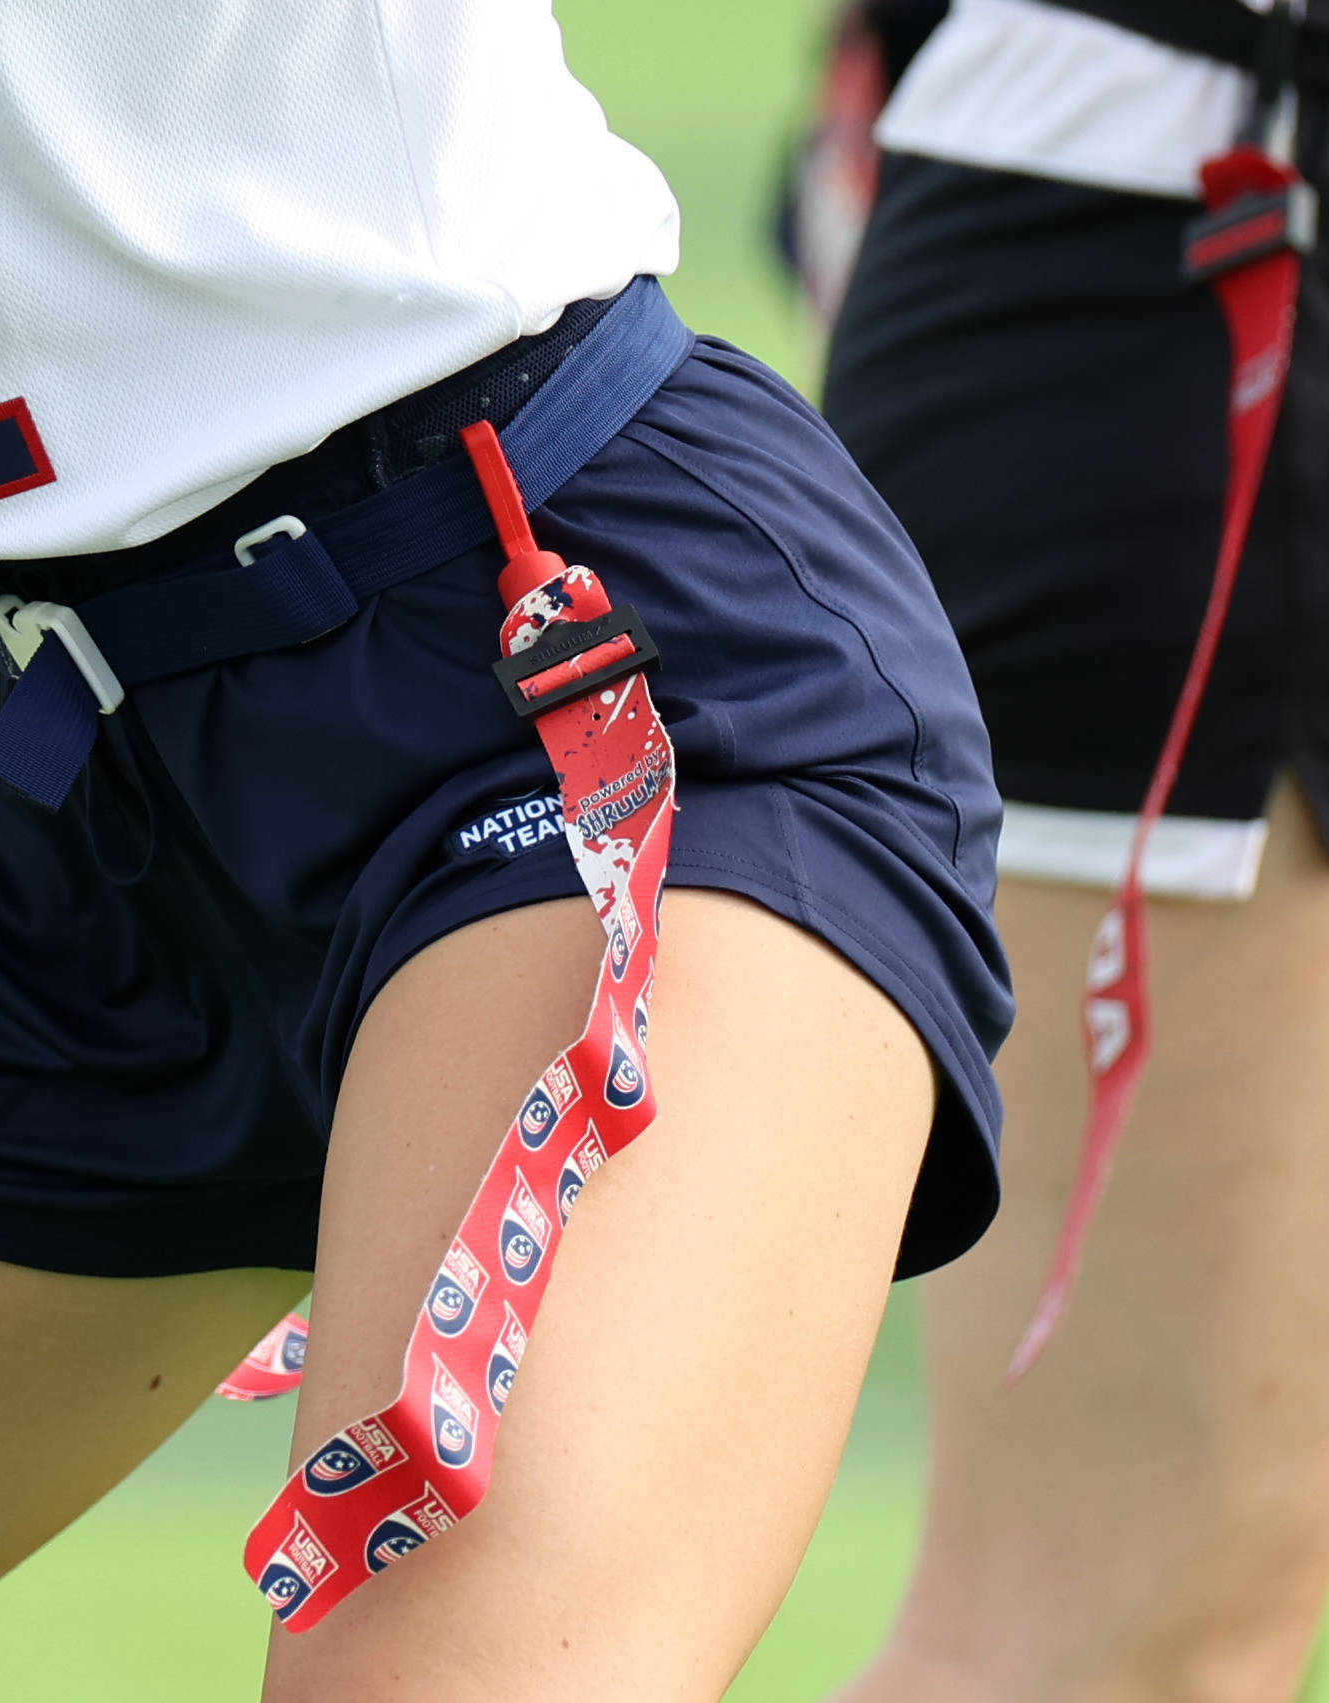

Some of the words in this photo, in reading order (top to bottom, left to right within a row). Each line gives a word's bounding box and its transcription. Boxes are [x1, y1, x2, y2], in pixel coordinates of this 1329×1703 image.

[579, 761, 647, 812] powered
[643, 749, 662, 778] by
[351, 1425, 385, 1467] OOTBALL
[293, 1528, 328, 1577] USA
